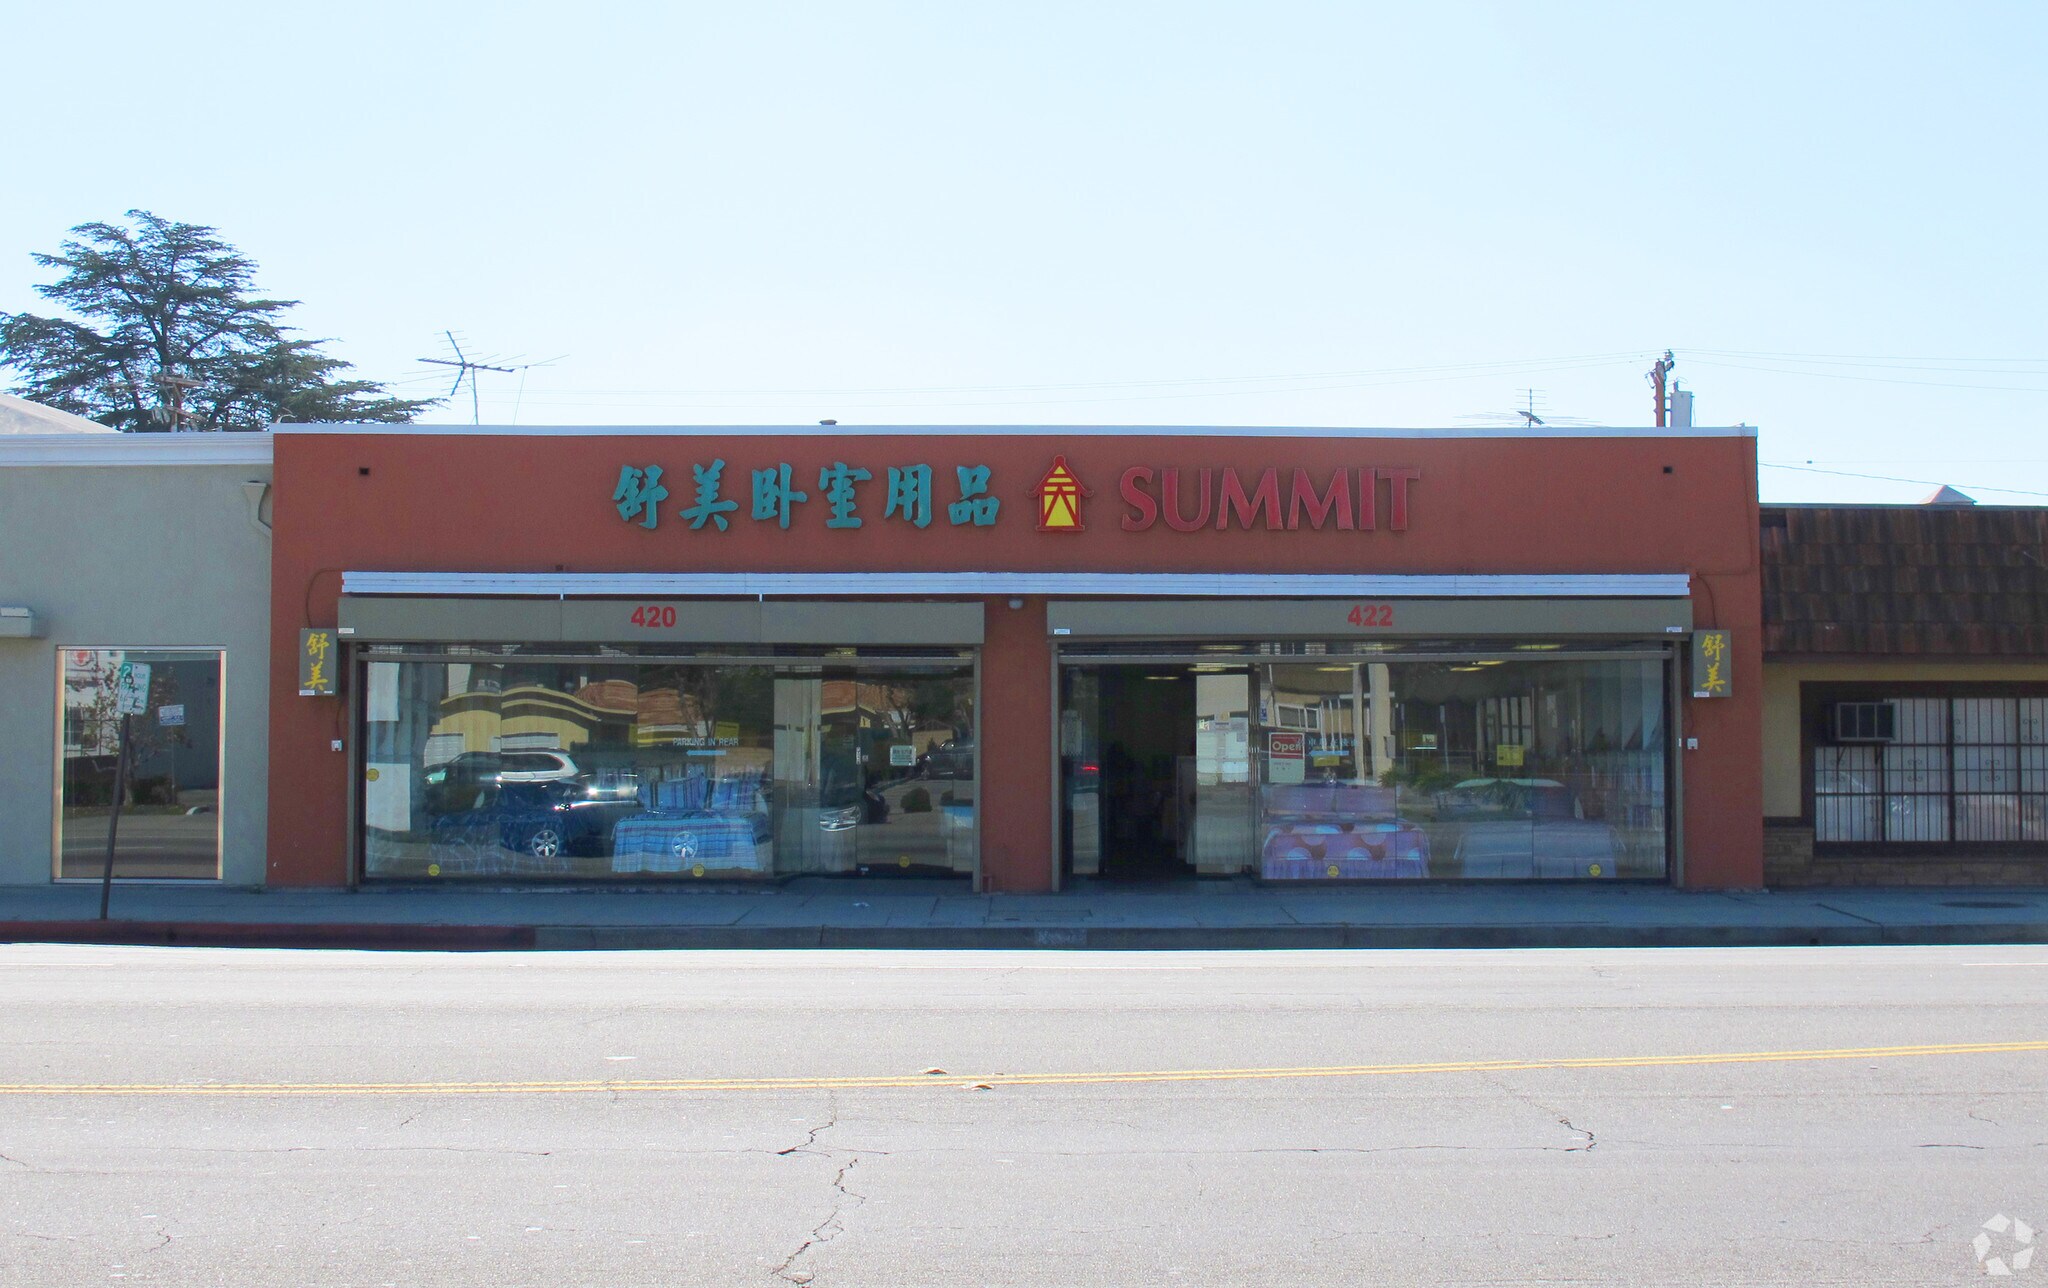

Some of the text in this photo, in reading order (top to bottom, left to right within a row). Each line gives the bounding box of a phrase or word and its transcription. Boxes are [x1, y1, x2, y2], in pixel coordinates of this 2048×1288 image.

[1120, 466, 1420, 532] SUMMIT
[630, 606, 676, 628] 420
[1347, 605, 1393, 627] 422
[123, 665, 131, 677] 2
[304, 633, 330, 691] 舒美
[1701, 634, 1726, 692] 舒美
[673, 737, 739, 746] PARKING IN REAR
[1272, 741, 1302, 752] Open
